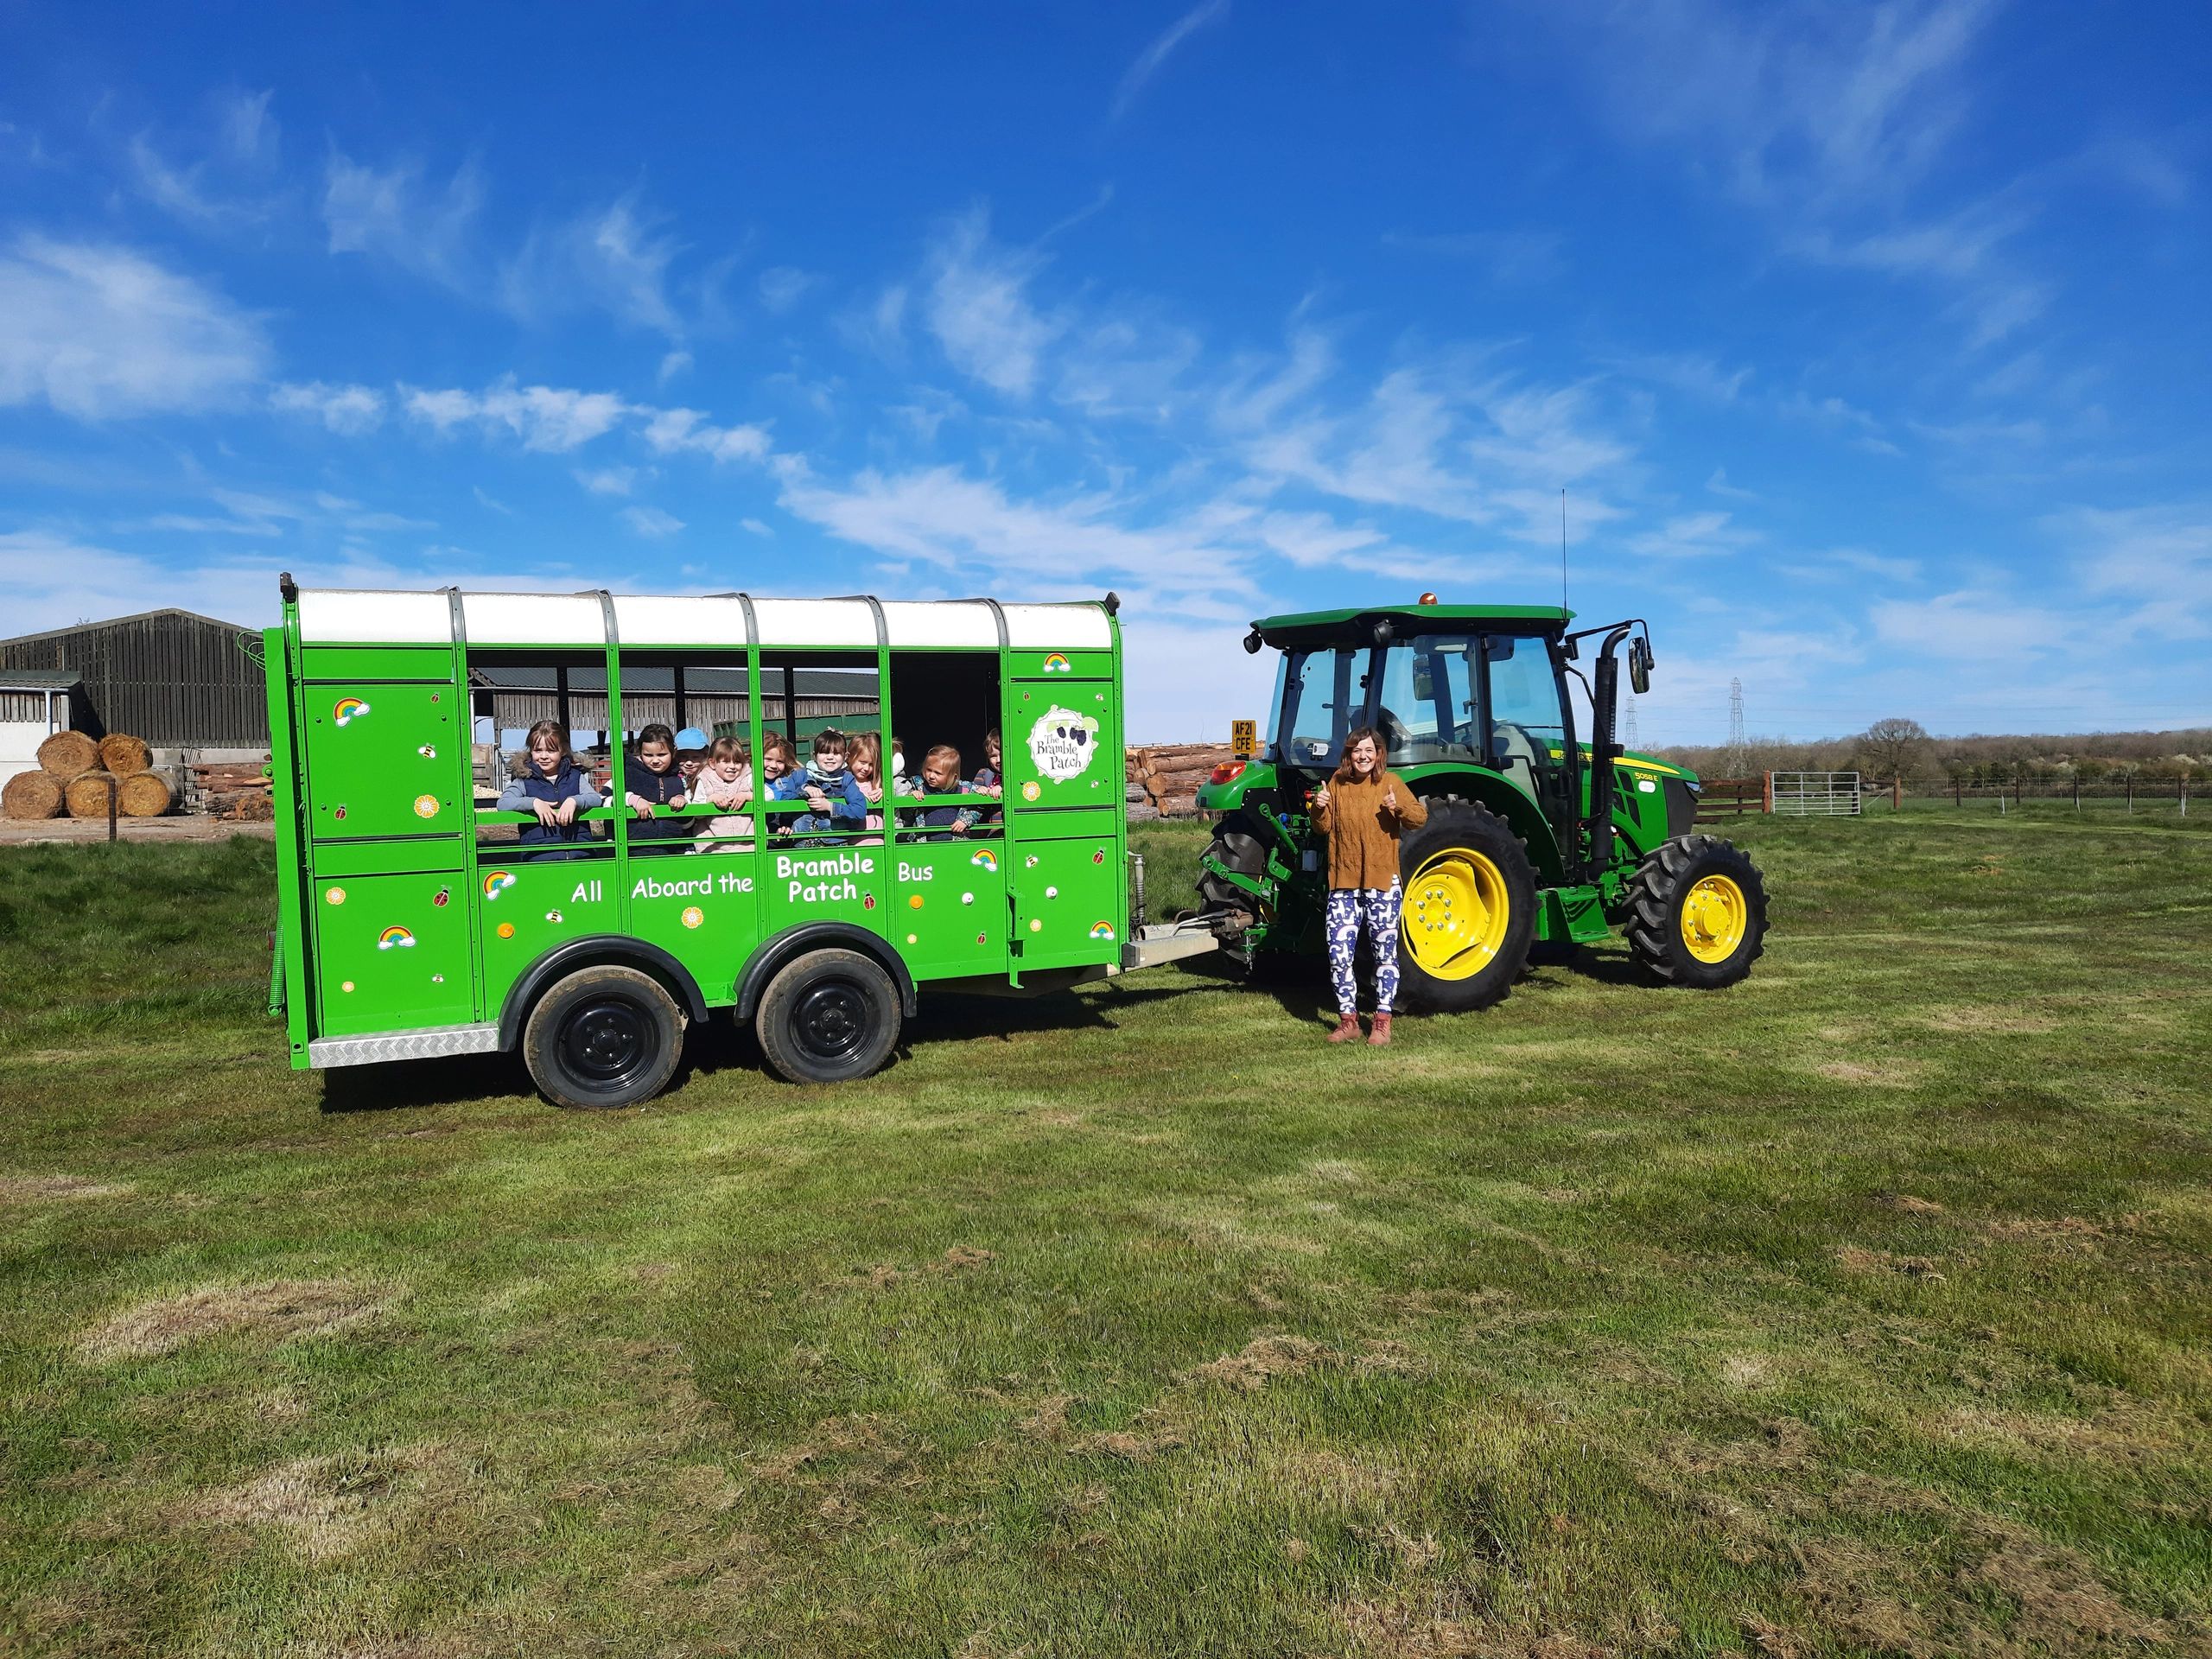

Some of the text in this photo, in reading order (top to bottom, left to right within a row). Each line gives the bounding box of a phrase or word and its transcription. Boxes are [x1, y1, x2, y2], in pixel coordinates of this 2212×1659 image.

[1235, 722, 1252, 735] AF21
[1044, 734, 1059, 744] The
[1236, 737, 1251, 750] CFE
[1037, 741, 1077, 755] Bramble
[1050, 753, 1082, 770] Patch
[777, 852, 874, 879] Bramble
[898, 861, 933, 882] Bus
[570, 872, 754, 903] All Aboard the
[789, 877, 857, 903] Patch
